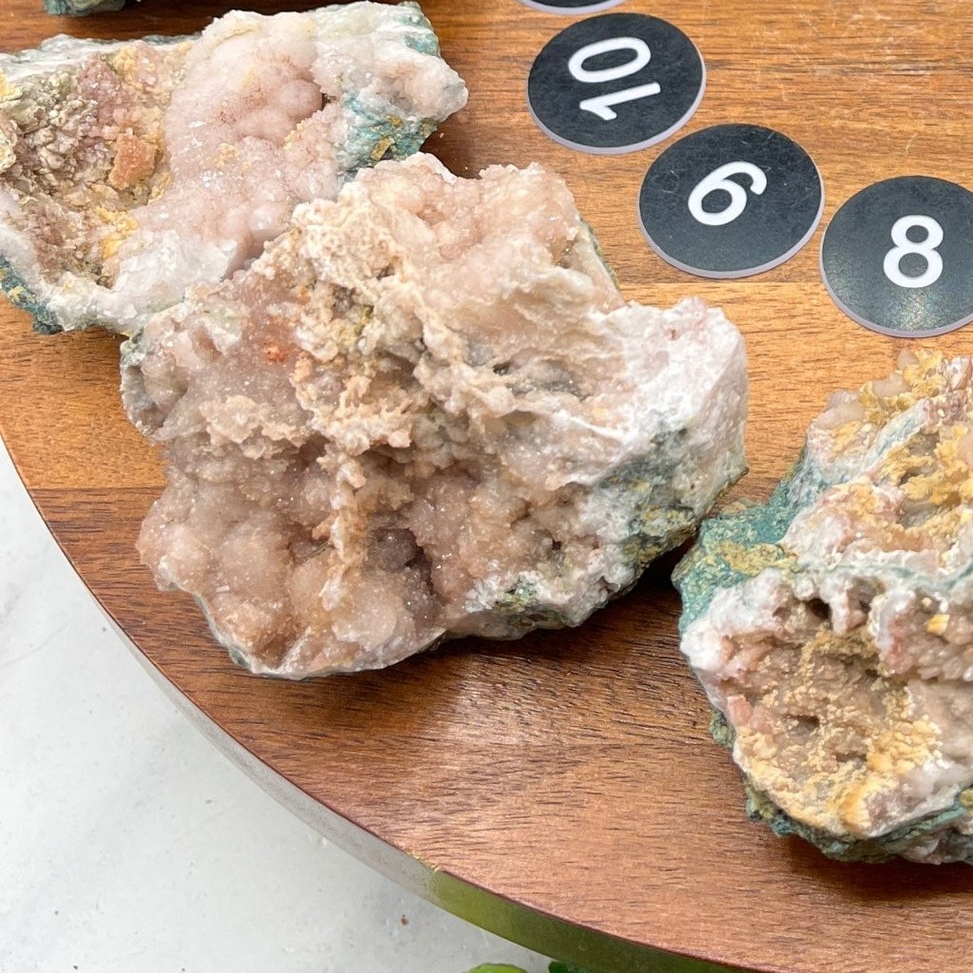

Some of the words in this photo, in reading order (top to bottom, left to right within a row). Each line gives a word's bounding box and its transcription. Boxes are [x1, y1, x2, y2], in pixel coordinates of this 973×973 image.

[567, 36, 661, 121] 10
[687, 161, 768, 227] 9
[882, 214, 944, 289] 8
